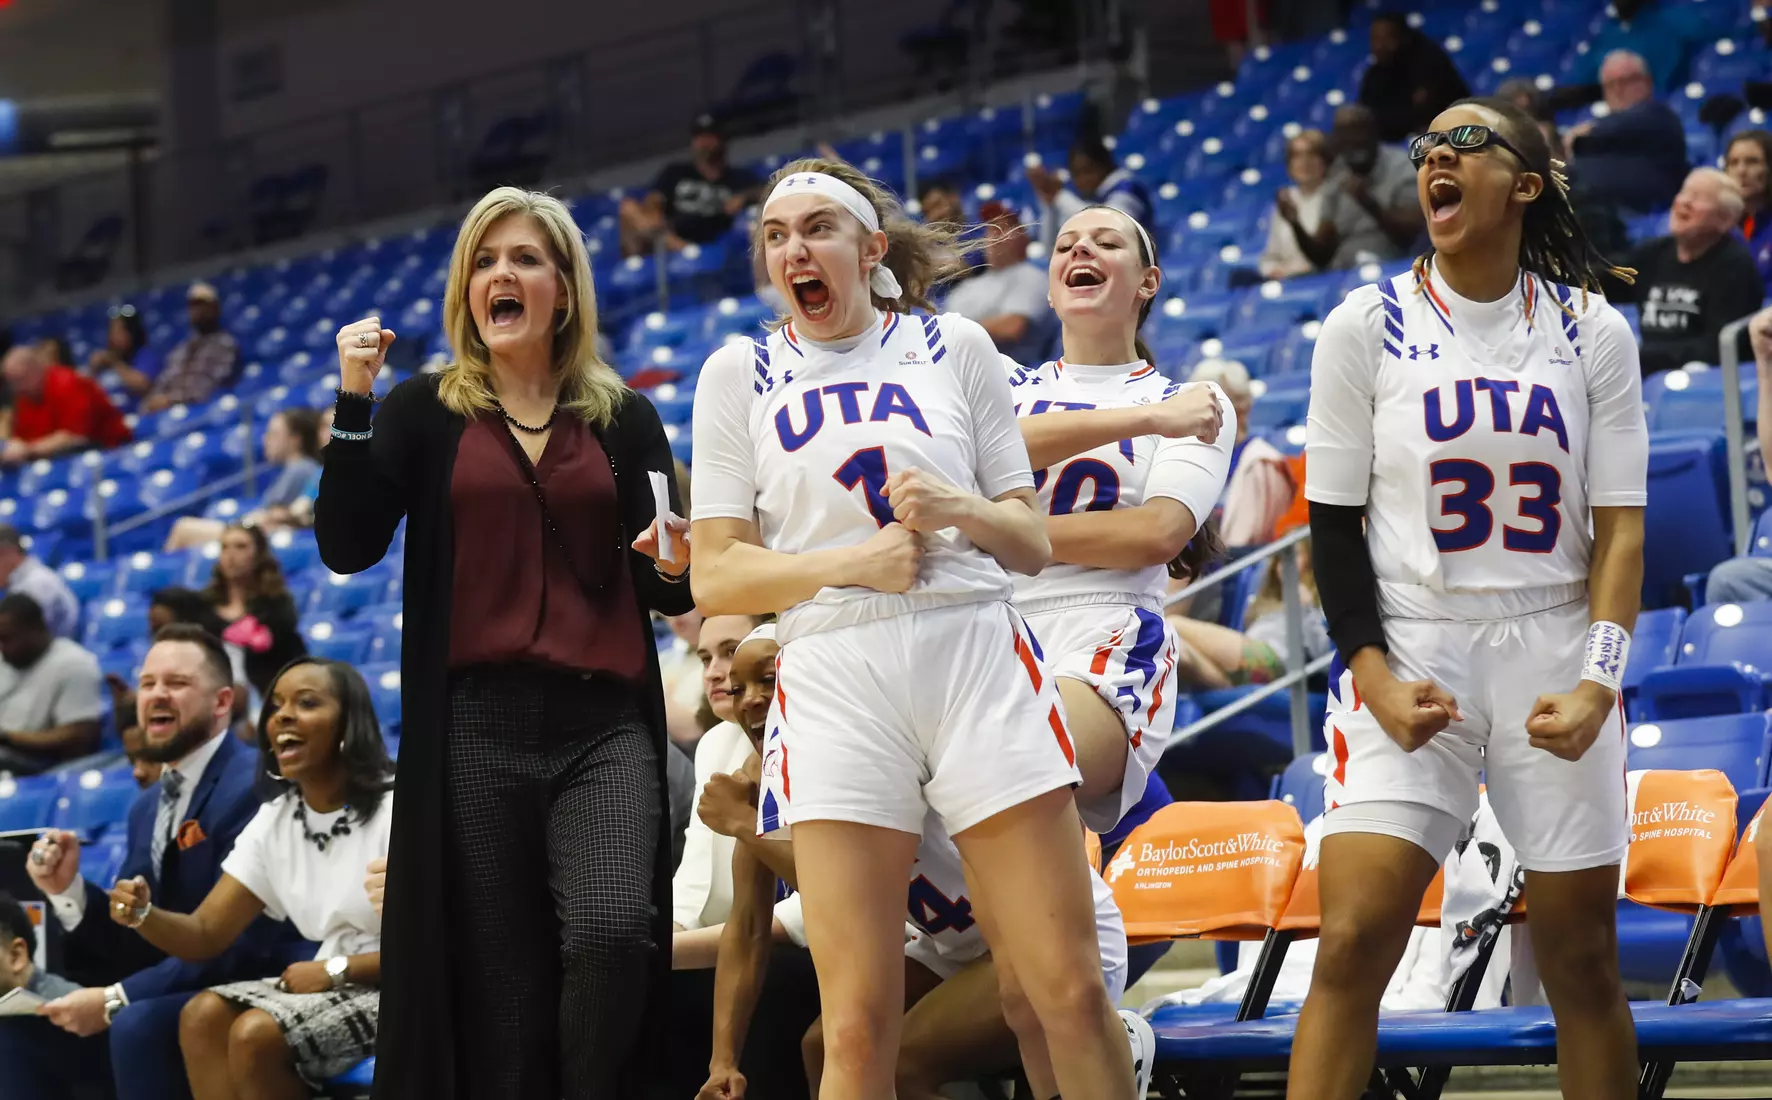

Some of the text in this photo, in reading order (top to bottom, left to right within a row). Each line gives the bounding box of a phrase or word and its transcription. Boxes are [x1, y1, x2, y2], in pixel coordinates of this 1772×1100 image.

[774, 381, 934, 453] UTA
[1422, 376, 1570, 454] UTA
[832, 445, 903, 530] 1
[1429, 458, 1562, 554] 33
[1631, 800, 1716, 826] ott&White
[1639, 829, 1662, 841] SPINE
[1663, 827, 1713, 840] HOSPITAL
[1136, 856, 1282, 877] ORTHOPEDIC AND SPINE HOSPITAL
